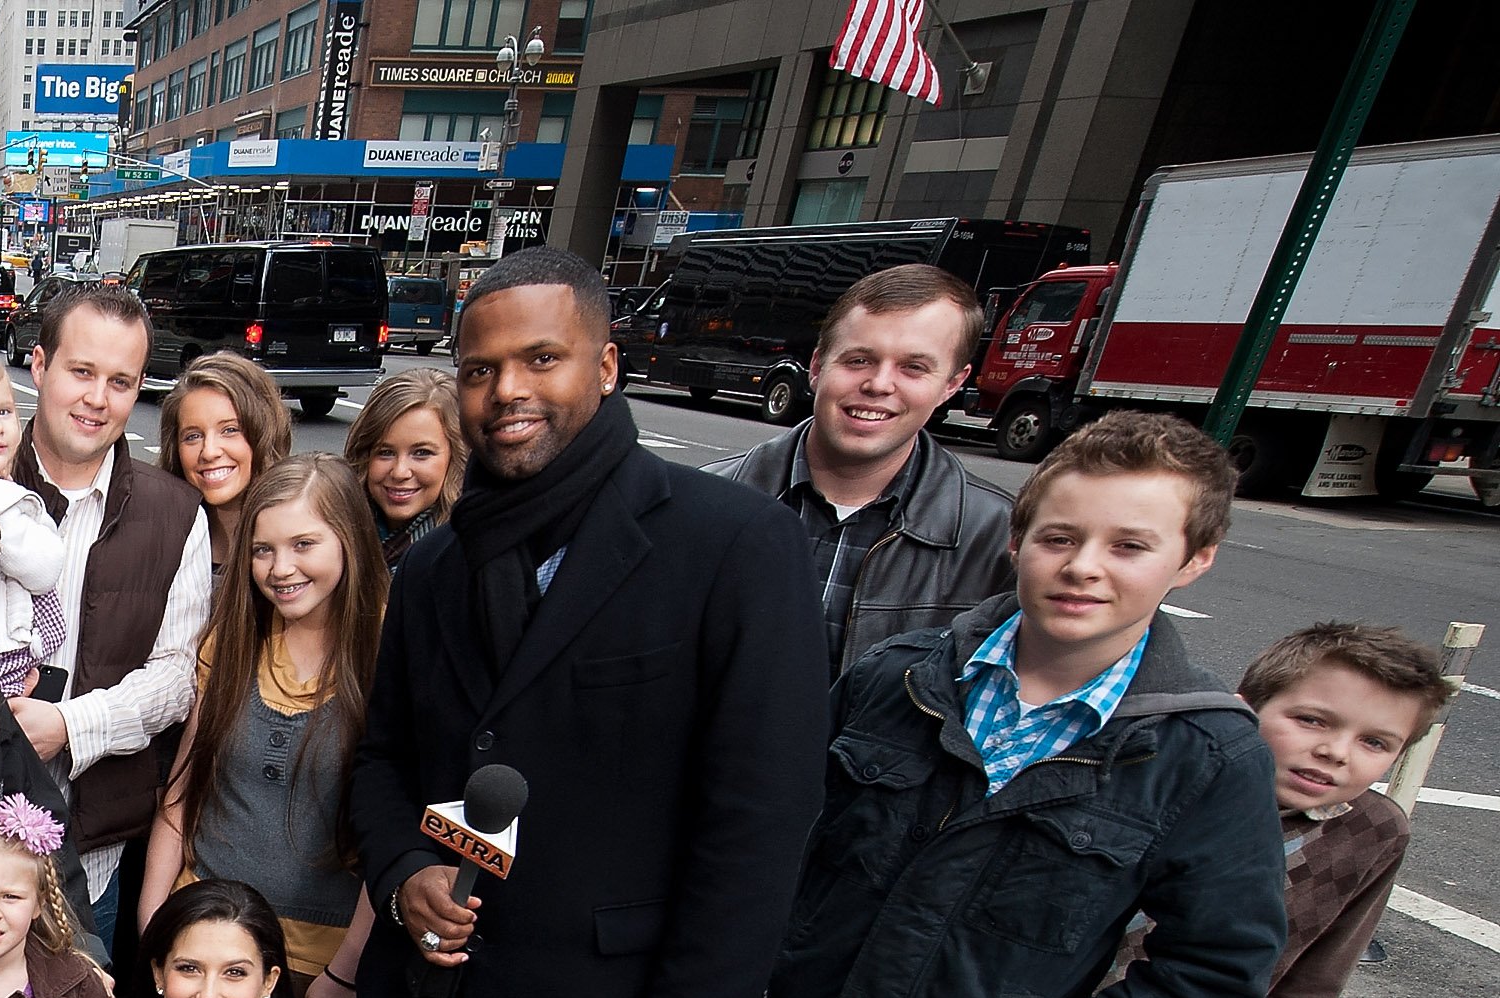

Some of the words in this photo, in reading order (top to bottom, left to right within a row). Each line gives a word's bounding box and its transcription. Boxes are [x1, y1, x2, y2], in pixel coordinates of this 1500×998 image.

[379, 67, 419, 81] TIMES
[421, 69, 474, 82] SQUARE
[545, 71, 575, 84] annex
[41, 75, 80, 98] The
[85, 76, 120, 103] Big
[53, 168, 68, 176] LEFT
[143, 171, 152, 179] St
[53, 177, 68, 185] TURN
[53, 185, 68, 193] LANE
